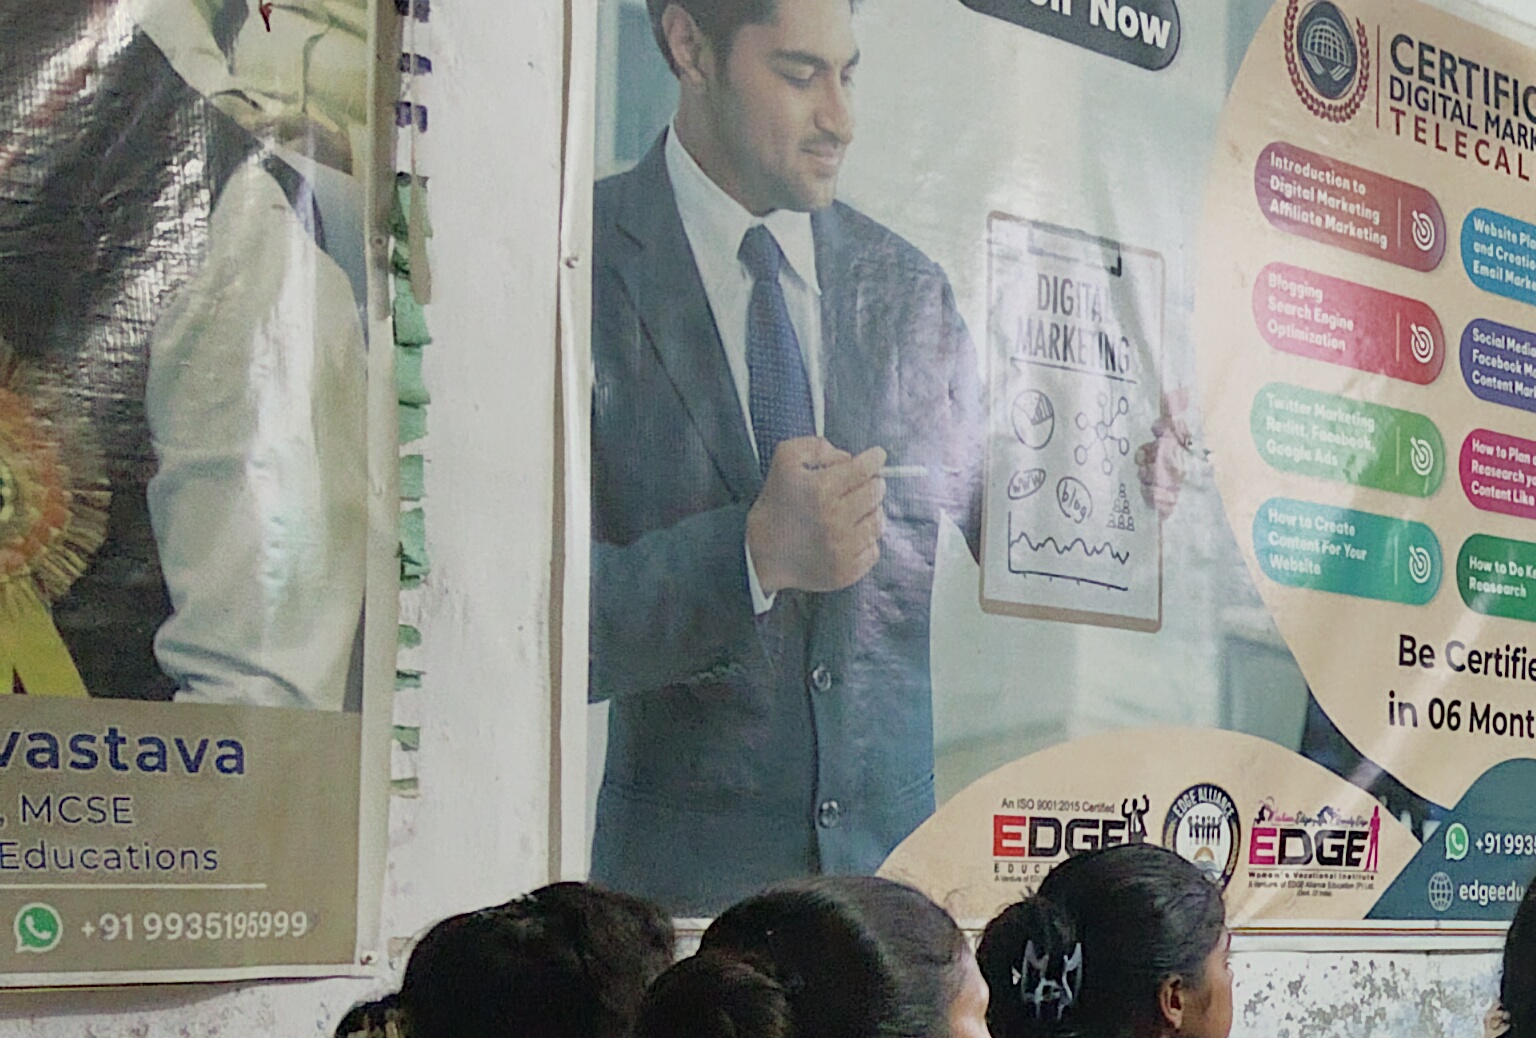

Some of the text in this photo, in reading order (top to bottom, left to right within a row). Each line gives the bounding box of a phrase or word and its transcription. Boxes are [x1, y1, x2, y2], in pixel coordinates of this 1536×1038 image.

[1090, 0, 1172, 49] Now
[1389, 74, 1478, 131] DIGITAL
[1270, 152, 1366, 195] Introduction to
[1270, 175, 1380, 225] Digital Marketing
[1270, 199, 1388, 248] Affiliate Marketing
[1473, 217, 1517, 246] Website
[1473, 241, 1493, 258] and
[1473, 260, 1503, 282] Email
[1268, 271, 1322, 304] Blogging
[1268, 296, 1354, 331] Search Engine
[1015, 316, 1131, 374] MARKETING
[1267, 319, 1345, 352] Optimization
[1472, 328, 1505, 349] Social
[1506, 336, 1536, 357] Media
[1472, 349, 1522, 375] Facebook
[1472, 370, 1513, 392] Content
[1267, 393, 1375, 433] Twitter Marketing
[1266, 439, 1338, 467] Google Ads
[1471, 438, 1493, 457] How
[1495, 445, 1506, 458] to
[1508, 447, 1531, 466] Plan
[1471, 460, 1524, 487] Reasearch
[1471, 480, 1513, 503] Content
[1513, 489, 1535, 508] Like
[1268, 508, 1356, 537] How to Create
[1268, 531, 1367, 561] Content For Your
[1269, 554, 1322, 576] Website
[1469, 556, 1491, 573] How
[1494, 562, 1507, 575] to
[1509, 562, 1525, 578] Do
[1469, 577, 1527, 599] Reasearch
[1398, 634, 1435, 669] Be
[1388, 690, 1418, 727] in
[1428, 697, 1462, 733] 06
[21, 794, 133, 825] MCSE
[1002, 797, 1115, 814] An ISO 9001:2015 Certified
[1173, 790, 1198, 818] EDGE
[1197, 786, 1235, 820] ALLIANCE
[993, 814, 1127, 857] EDGE
[1249, 827, 1369, 867] EDGE
[1475, 832, 1501, 854] +91
[0, 840, 219, 872] Educations
[1293, 871, 1337, 880] Vocational
[1339, 872, 1375, 881] Institute
[81, 911, 308, 942] +91 9935195999
